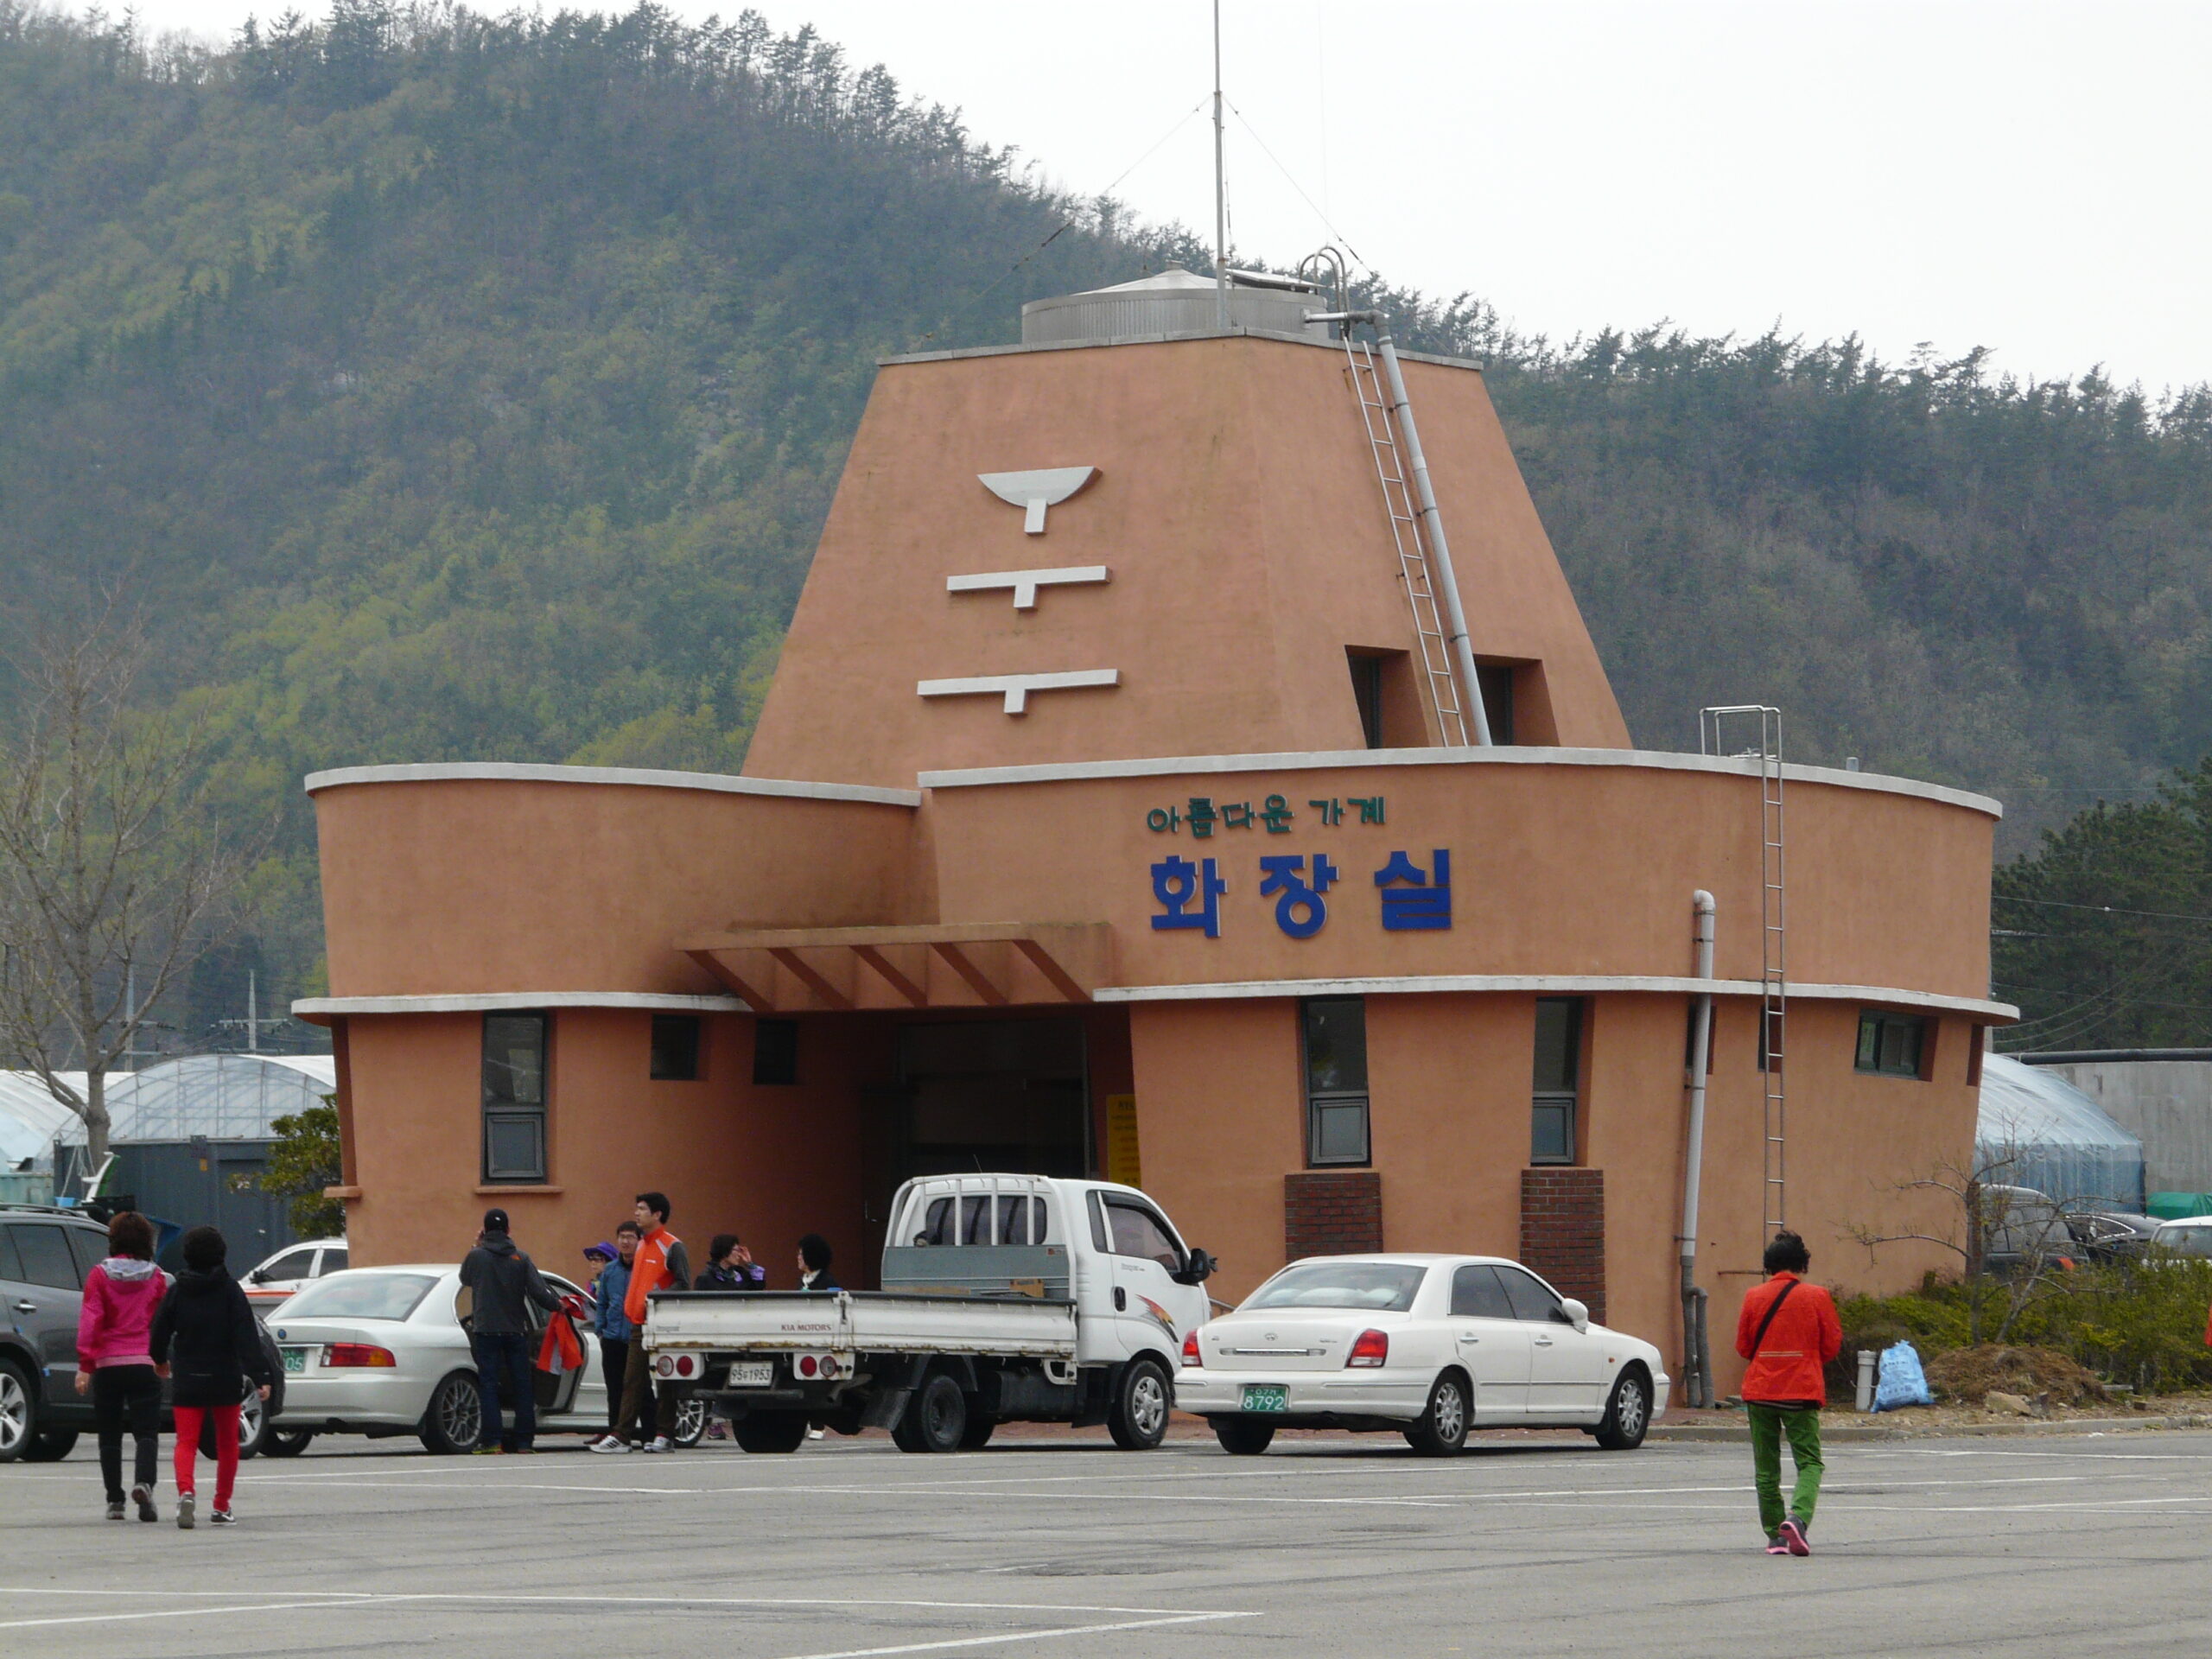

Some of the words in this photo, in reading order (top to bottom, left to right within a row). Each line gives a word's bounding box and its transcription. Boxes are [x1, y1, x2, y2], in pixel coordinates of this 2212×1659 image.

[1147, 793, 1295, 839] 아름다운
[1150, 849, 1452, 939] 화장실
[1243, 1395, 1284, 1410] 8792
